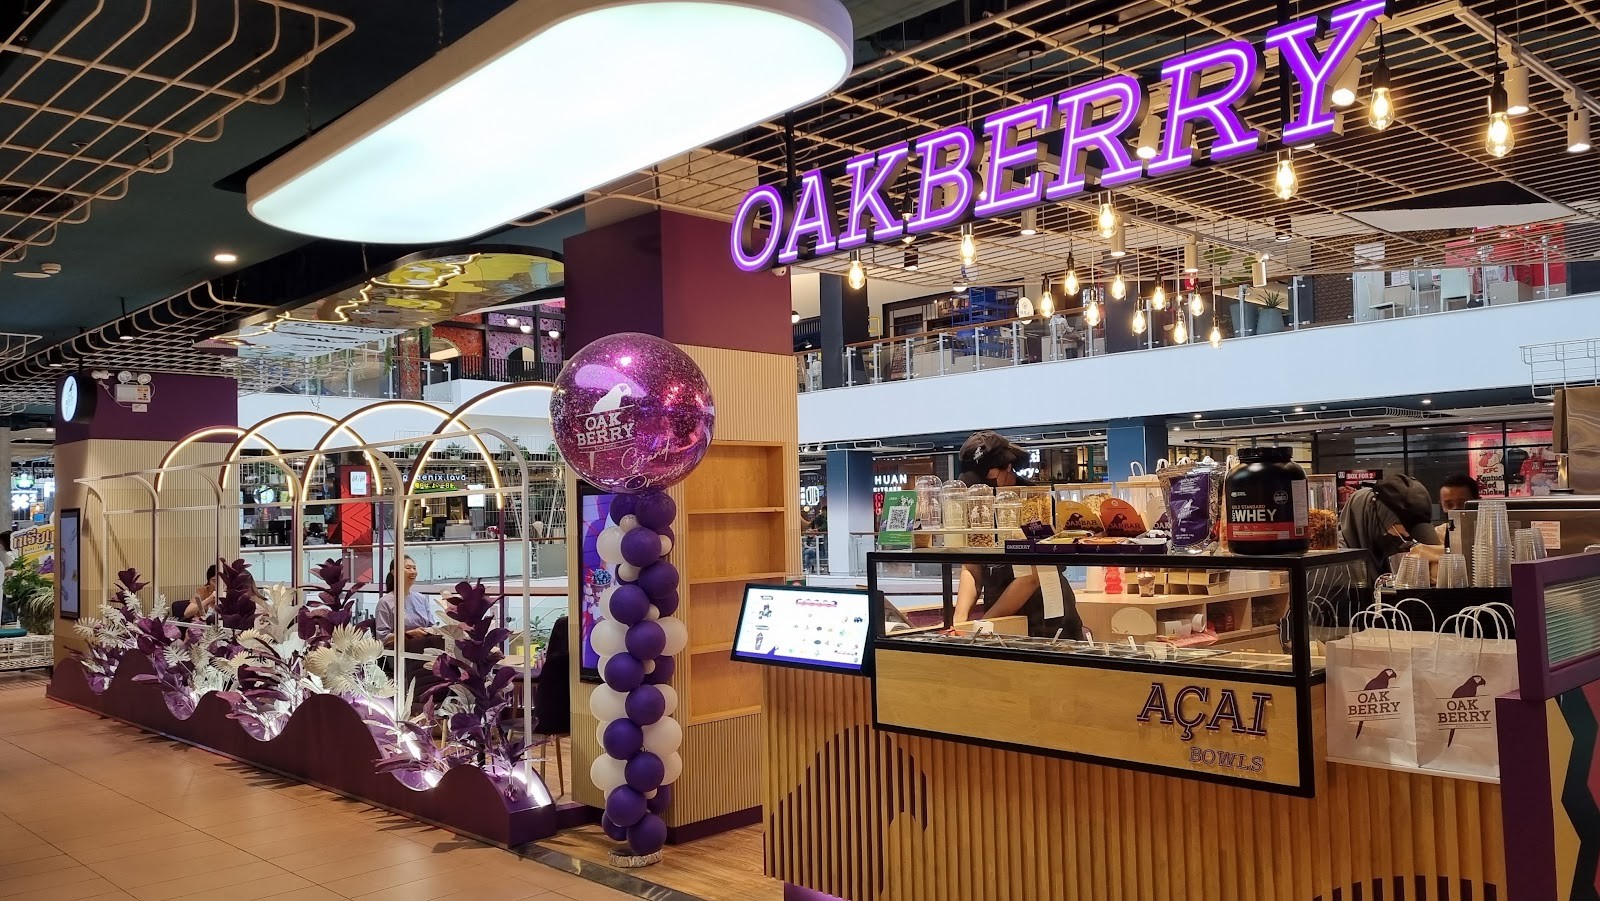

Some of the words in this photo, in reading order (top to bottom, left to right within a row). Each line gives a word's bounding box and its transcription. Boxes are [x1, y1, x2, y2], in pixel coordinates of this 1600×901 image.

[730, 0, 1387, 272] OAKBERRY
[584, 411, 622, 431] OAK
[576, 422, 636, 446] BERRY
[621, 437, 671, 474] Grand
[402, 473, 467, 483] poenix.lava
[874, 473, 908, 485] HUAN
[1234, 508, 1277, 522] WHEY
[1357, 690, 1390, 704] OAK
[1347, 701, 1401, 716] BERRY
[1446, 699, 1479, 711] OAK
[1437, 710, 1491, 724] BERRY
[1189, 746, 1264, 773] BOWLS
